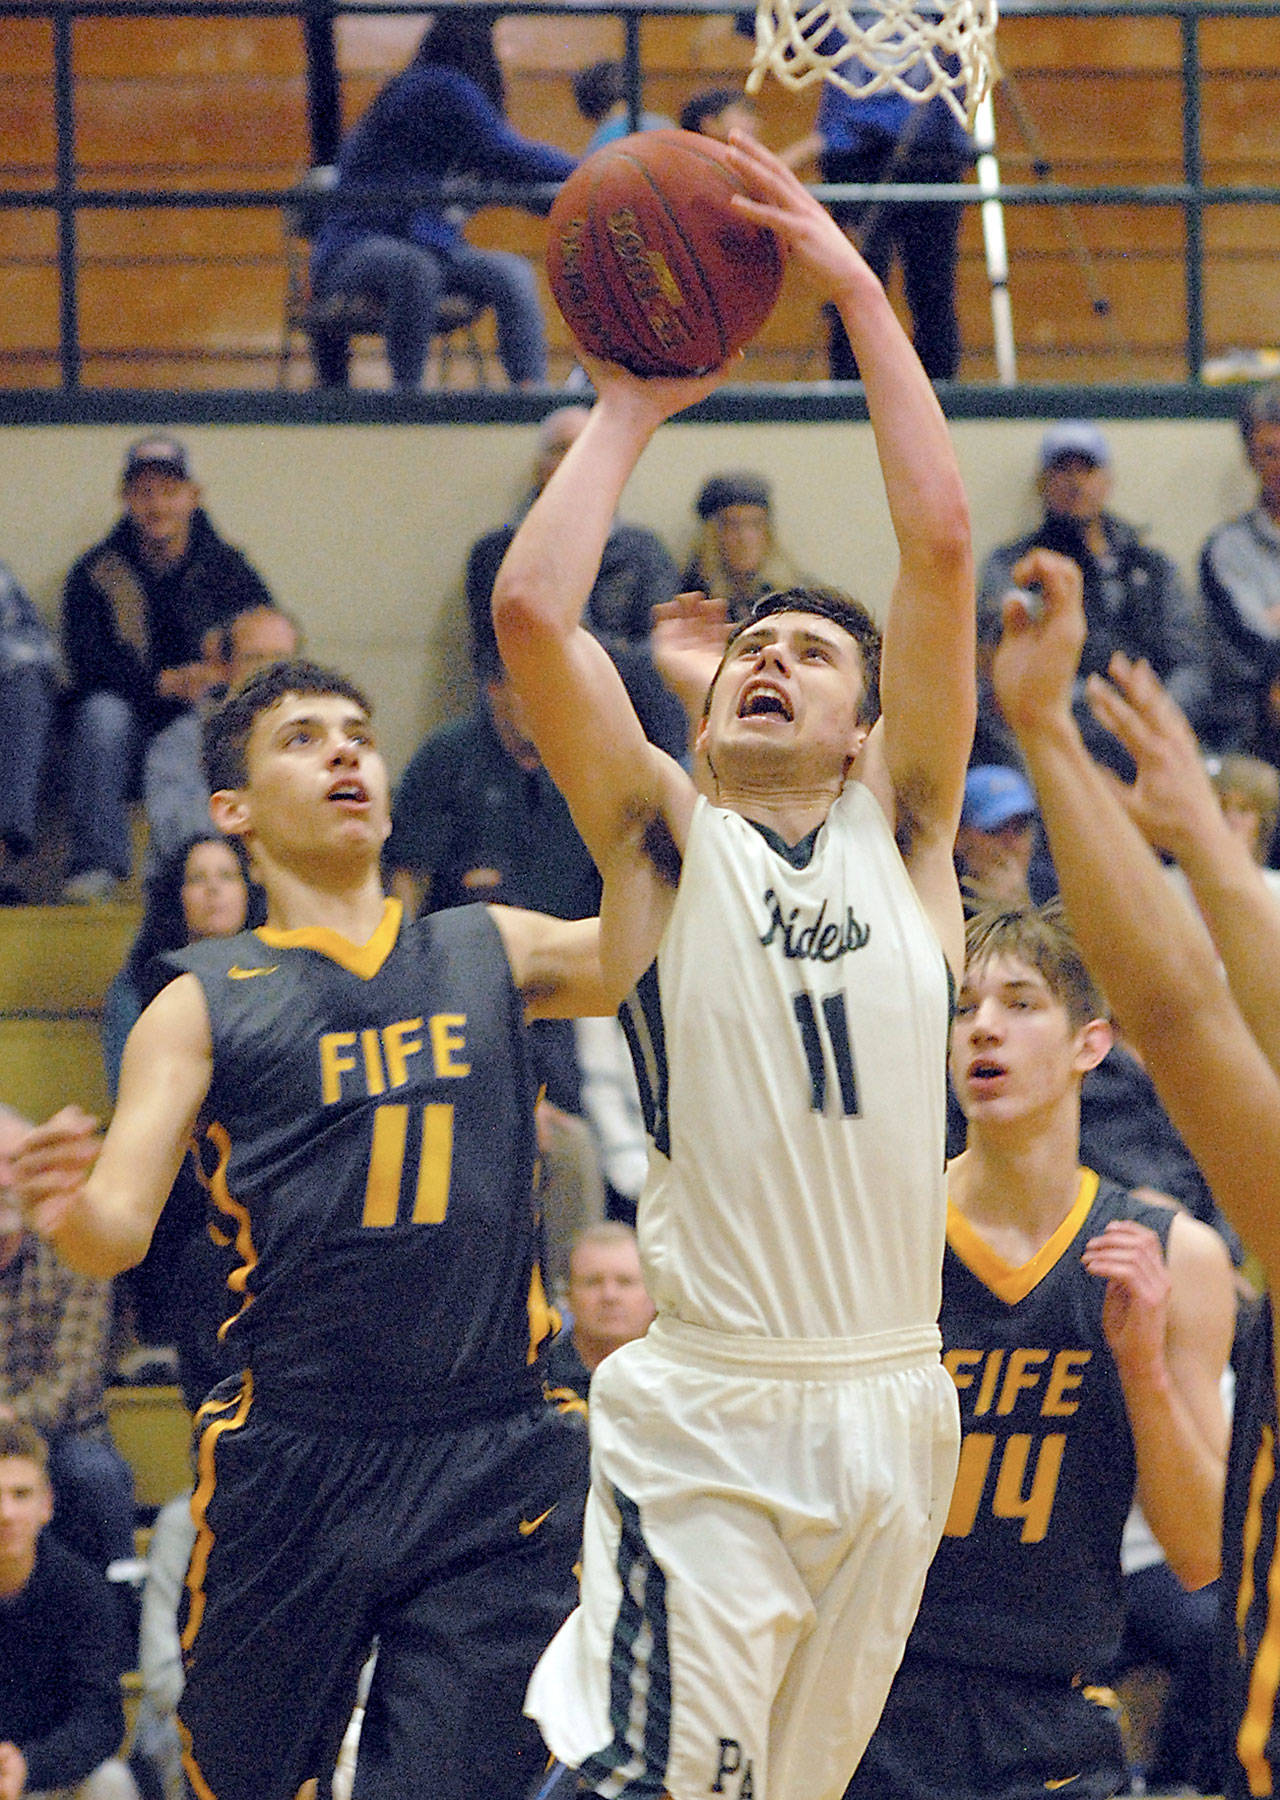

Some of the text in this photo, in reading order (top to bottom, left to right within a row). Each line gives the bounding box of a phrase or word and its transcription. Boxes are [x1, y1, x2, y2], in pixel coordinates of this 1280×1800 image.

[319, 1014, 471, 1104] FIFE
[791, 987, 862, 1119] 11
[361, 1104, 454, 1228] 11
[943, 1349, 1093, 1416] FIFE
[943, 1432, 1067, 1543] 14
